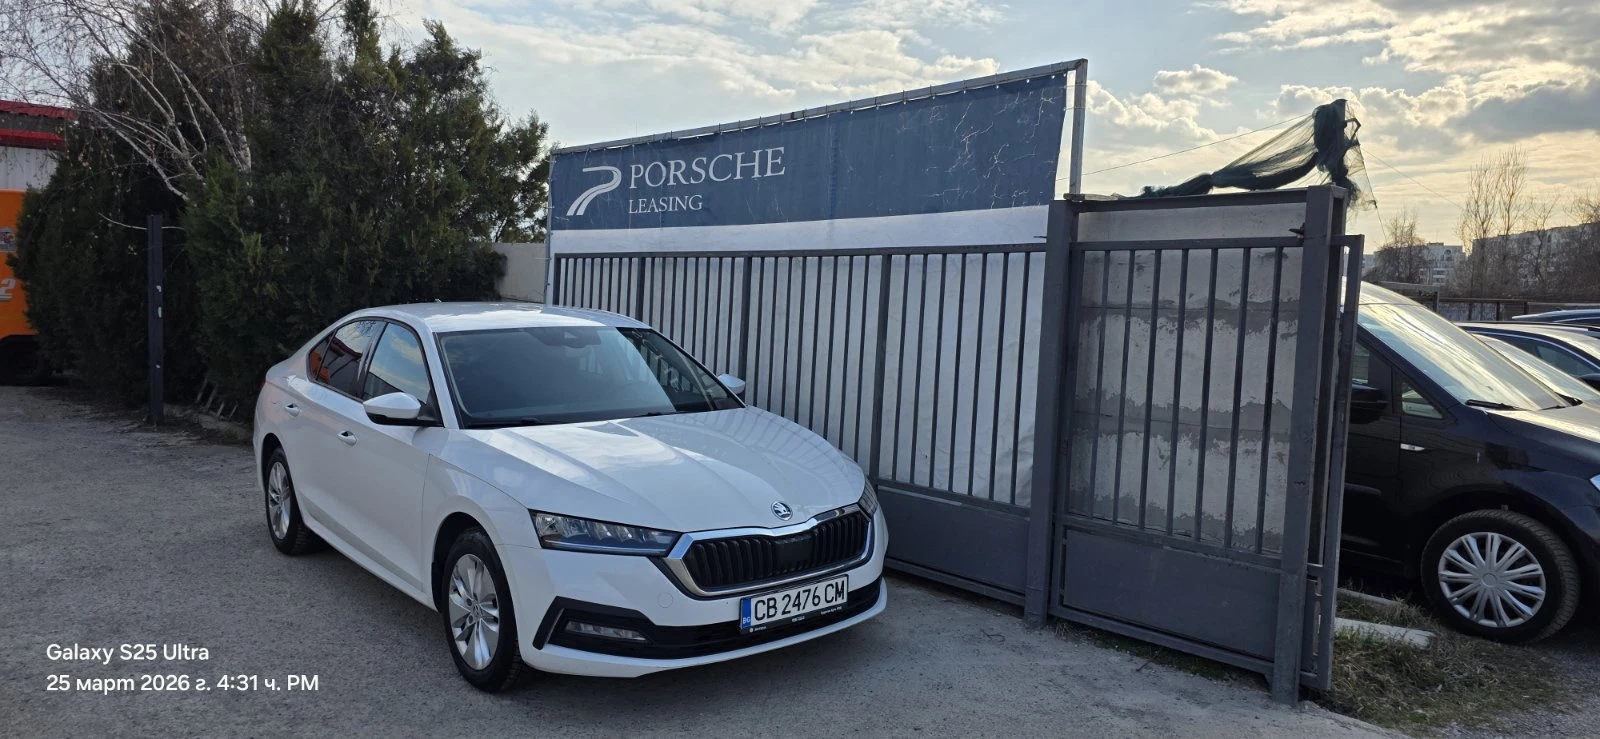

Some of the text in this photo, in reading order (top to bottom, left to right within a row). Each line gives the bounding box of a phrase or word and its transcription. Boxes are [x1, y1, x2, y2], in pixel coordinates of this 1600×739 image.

[629, 146, 786, 189] PORSCHE
[628, 195, 703, 214] LEASING
[754, 580, 845, 621] CB 2476 CM
[742, 616, 751, 625] BG
